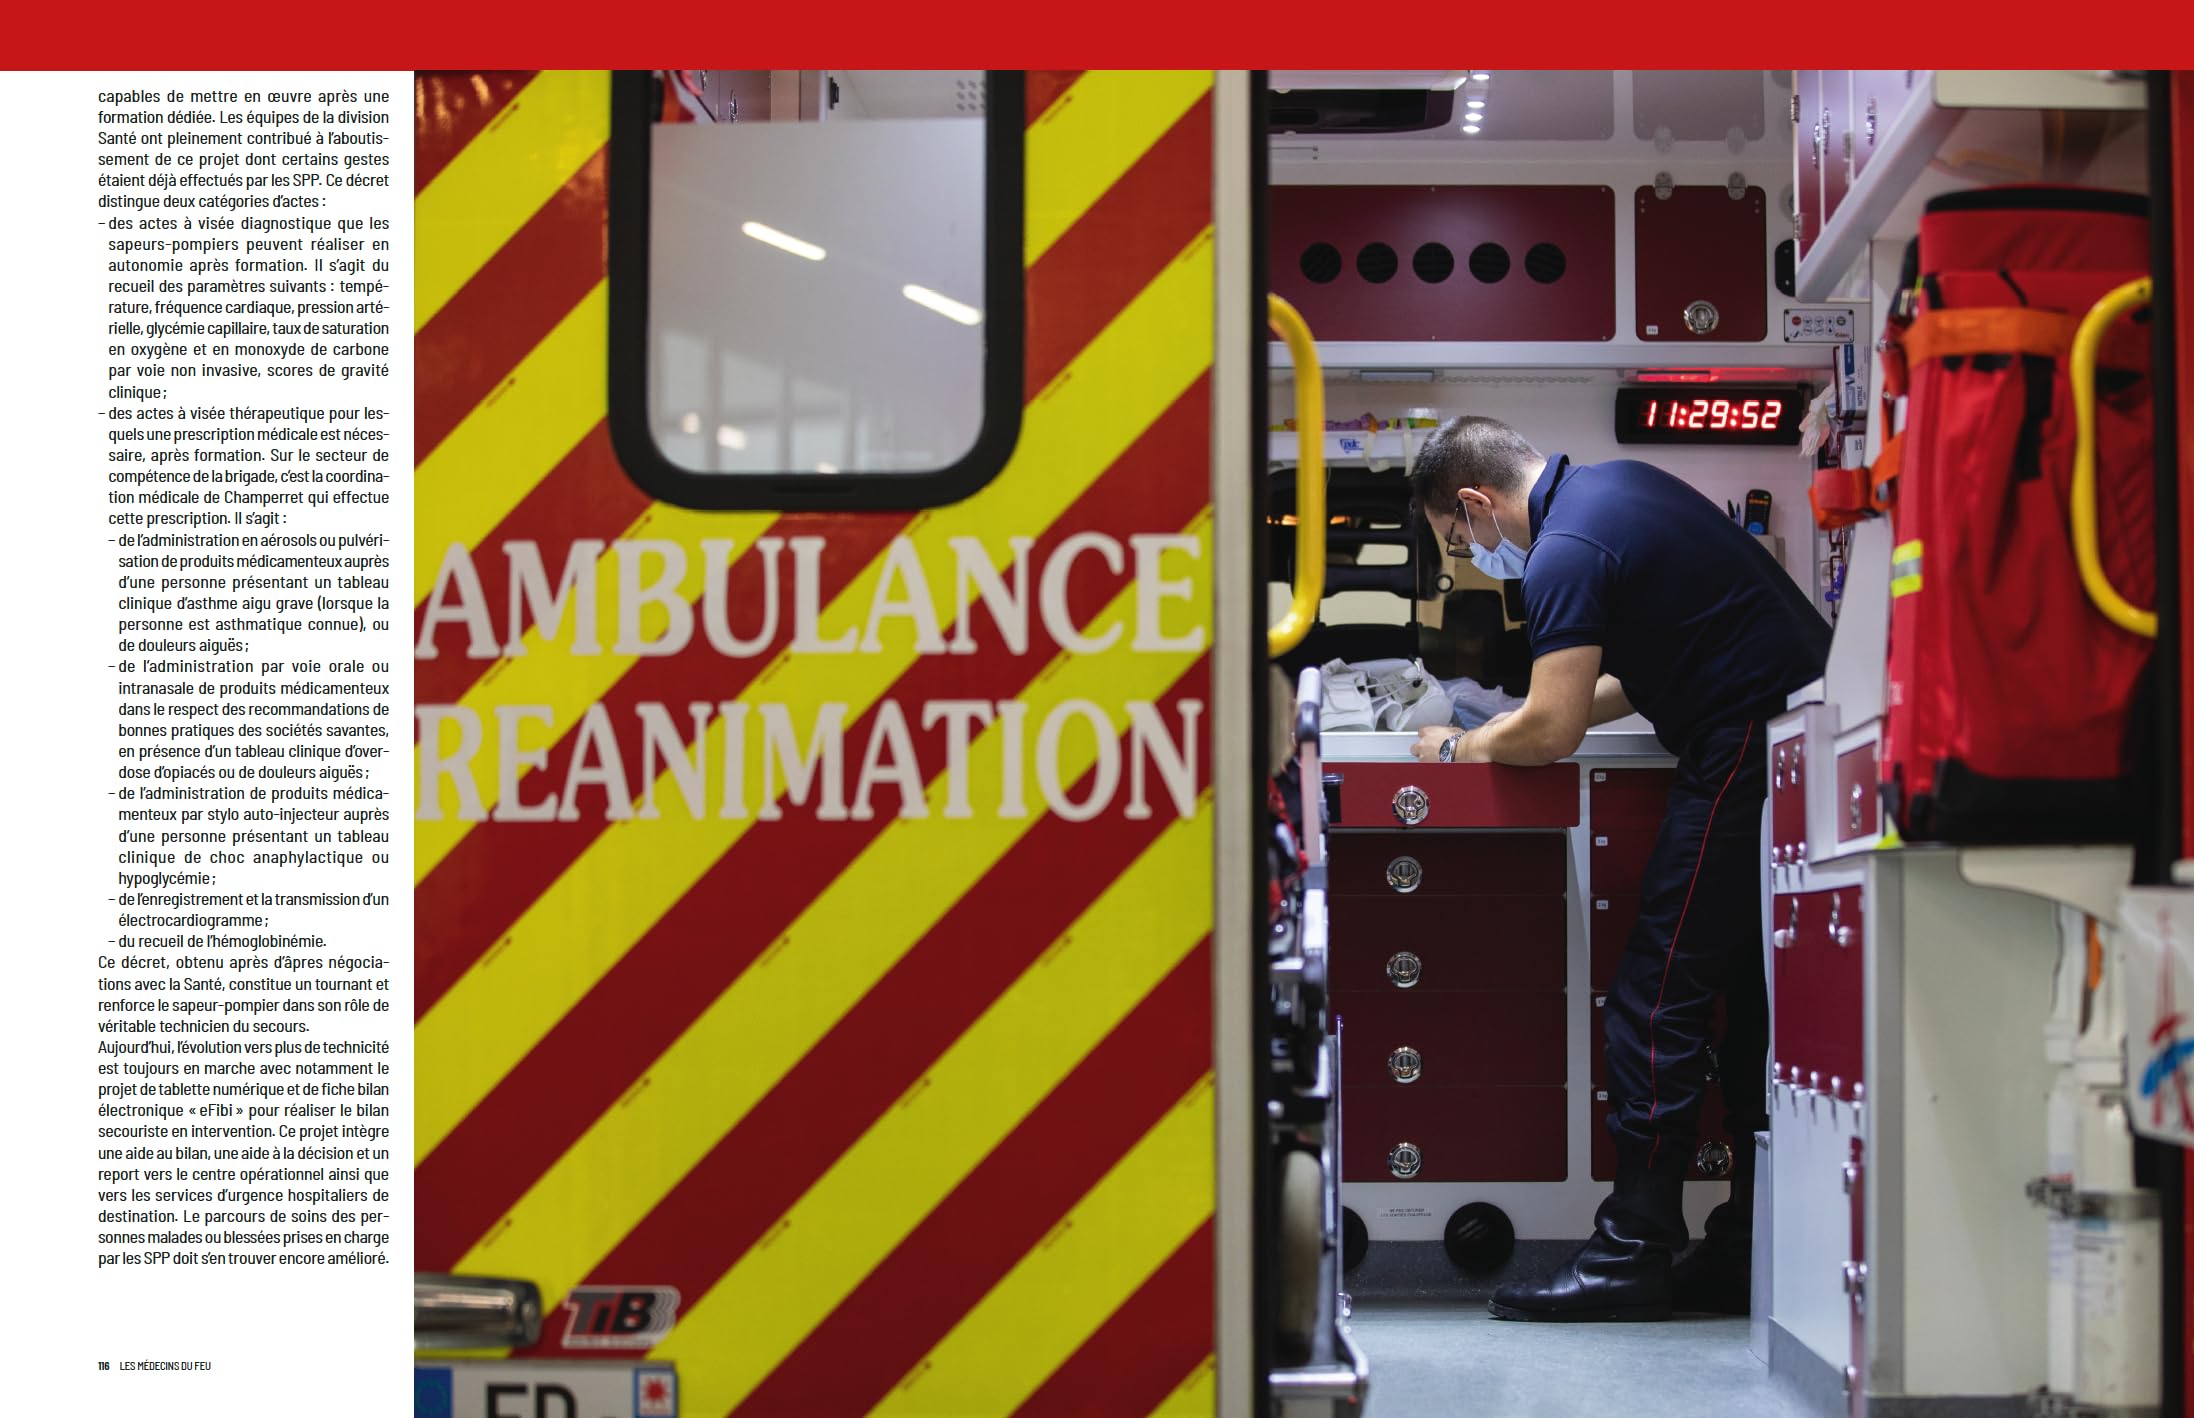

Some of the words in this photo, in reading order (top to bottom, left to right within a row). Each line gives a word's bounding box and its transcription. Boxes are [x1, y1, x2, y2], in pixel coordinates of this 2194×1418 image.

[98, 89, 161, 107] capables
[166, 89, 184, 103] de
[190, 90, 238, 103] mettre
[244, 92, 261, 103] en
[267, 92, 312, 103] œuvre
[318, 88, 358, 107] après
[364, 92, 390, 103] une
[97, 110, 164, 124] formation
[167, 109, 216, 124] dédiée.
[220, 110, 244, 124] Les
[246, 109, 300, 128] équipes
[302, 110, 320, 124] de
[323, 110, 335, 124] la
[337, 110, 389, 124] division
[108, 237, 239, 255] sapeurs-pompiers
[246, 238, 304, 255] peuvent
[311, 236, 366, 251] réaliser
[372, 240, 389, 251] en
[108, 301, 153, 315] rature,
[154, 299, 223, 318] fréquence
[225, 300, 295, 318] cardiaque,
[297, 300, 354, 318] pression
[356, 299, 390, 314] arté-
[108, 321, 144, 336] rielle,
[146, 321, 205, 339] glycémie
[207, 321, 270, 339] capillaire,
[272, 322, 302, 335] taux
[303, 321, 320, 335] de
[321, 321, 389, 335] saturation
[108, 366, 132, 381] par
[136, 363, 165, 377] voie
[171, 366, 196, 377] non
[202, 363, 261, 378] invasive,
[267, 366, 313, 377] scores
[318, 363, 336, 377] de
[341, 362, 389, 381] gravité
[1647, 400, 1783, 429] 11:29:52
[108, 427, 145, 445] quels
[146, 430, 172, 441] une
[173, 427, 255, 445] prescription
[257, 427, 318, 441] médicale
[320, 428, 342, 441] est
[343, 426, 390, 441] néces-
[108, 448, 146, 463] saire,
[150, 447, 190, 466] après
[193, 448, 265, 462] formation.
[270, 448, 295, 462] Sur
[298, 448, 311, 462] le
[315, 449, 368, 462] secteur
[372, 448, 389, 462] de
[108, 490, 135, 504] tion
[138, 489, 200, 504] médicale
[203, 490, 220, 504] de
[224, 490, 304, 508] Champerret
[307, 490, 329, 508] qui
[332, 490, 390, 504] effectue
[414, 532, 1206, 660] AMBULANCE
[118, 620, 183, 635] personne
[188, 618, 211, 631] est
[215, 617, 302, 635] asthmatique
[307, 615, 367, 633] connue),
[372, 620, 389, 631] ou
[118, 681, 194, 695] intranasale
[198, 681, 215, 695] de
[219, 681, 276, 699] produits
[280, 680, 390, 695] médicamenteux
[118, 702, 151, 716] dans
[153, 702, 165, 716] le
[168, 703, 220, 720] respect
[221, 702, 246, 716] des
[248, 702, 370, 716] recommandations
[372, 702, 390, 716] de
[118, 723, 168, 737] bonnes
[171, 723, 235, 741] pratiques
[238, 723, 263, 737] des
[265, 722, 323, 737] sociétés
[326, 724, 389, 738] savantes,
[414, 699, 1204, 822] REANIMATION
[118, 808, 177, 821] menteux
[181, 810, 204, 825] par
[207, 807, 240, 825] stylo
[243, 807, 340, 825] auto-injecteur
[343, 806, 390, 825] auprès
[118, 850, 176, 868] clinique
[184, 850, 202, 864] de
[209, 850, 245, 864] choc
[252, 850, 363, 868] anaphylactique
[371, 853, 389, 864] ou
[97, 977, 132, 991] tions
[134, 980, 166, 991] avec
[169, 977, 181, 991] la
[183, 976, 226, 992] Santé,
[228, 977, 292, 991] constitue
[295, 980, 312, 991] un
[314, 978, 373, 991] tournant
[375, 978, 390, 991] et
[98, 998, 155, 1012] renforce
[158, 998, 170, 1012] le
[172, 998, 281, 1016] sapeur-pompier
[282, 998, 315, 1012] dans
[317, 1001, 342, 1012] son
[344, 998, 370, 1012] rôle
[372, 998, 390, 1012] de
[97, 1019, 156, 1033] véritable
[159, 1019, 230, 1033] technicien
[232, 1019, 250, 1033] du
[252, 1022, 310, 1033] secours.
[98, 1062, 120, 1075] est
[123, 1061, 180, 1079] toujours
[183, 1064, 200, 1075] en
[204, 1061, 256, 1075] marche
[259, 1064, 292, 1075] avec
[295, 1062, 374, 1075] notamment
[377, 1061, 390, 1075] le
[98, 1124, 169, 1138] secouriste
[171, 1127, 188, 1138] en
[191, 1124, 276, 1138] intervention.
[279, 1124, 296, 1138] Ce
[299, 1124, 339, 1142] projet
[342, 1123, 390, 1142] intègre
[98, 1168, 140, 1185] report
[143, 1170, 173, 1181] vers
[176, 1167, 188, 1181] le
[192, 1168, 236, 1181] centre
[239, 1166, 324, 1185] opérationnel
[328, 1167, 360, 1181] ainsi
[364, 1170, 389, 1185] que
[98, 1209, 178, 1223] destination.
[183, 1209, 200, 1223] Le
[204, 1212, 266, 1227] parcours
[269, 1209, 287, 1223] de
[291, 1209, 327, 1223] soins
[331, 1209, 356, 1223] des
[360, 1212, 390, 1227] per-
[98, 1233, 146, 1244] sonnes
[147, 1230, 203, 1244] malades
[204, 1233, 222, 1244] ou
[223, 1230, 281, 1244] blessées
[283, 1230, 324, 1248] prises
[325, 1233, 342, 1244] en
[343, 1230, 390, 1248] charge
[97, 1361, 111, 1371] 116
[119, 1361, 136, 1371] LES
[137, 1359, 180, 1371] MÉDECINS
[180, 1361, 193, 1371] DU
[194, 1361, 212, 1371] FEU
